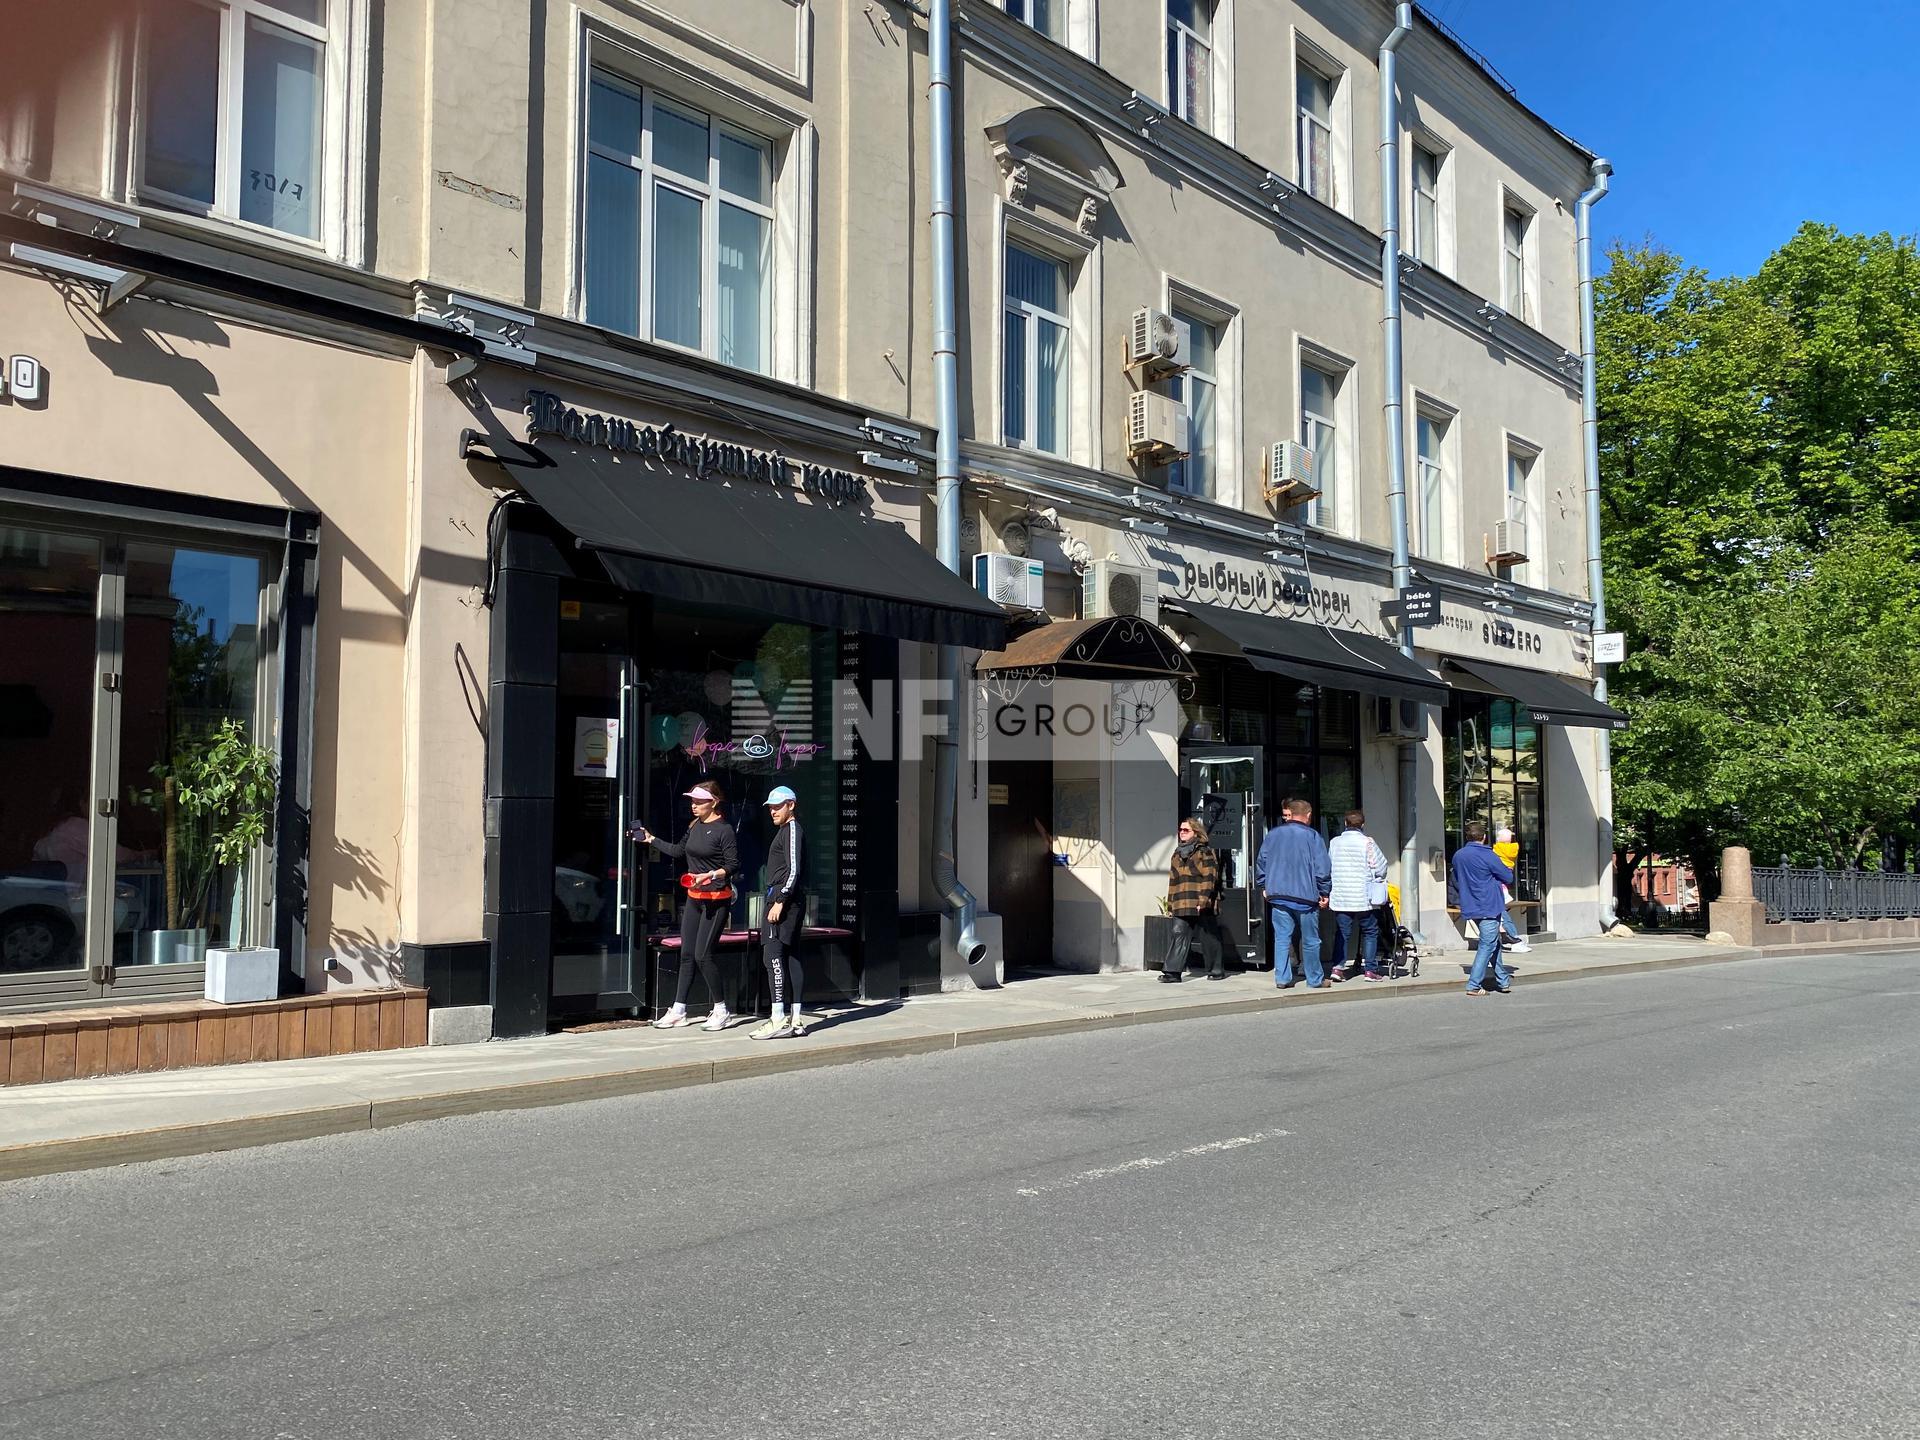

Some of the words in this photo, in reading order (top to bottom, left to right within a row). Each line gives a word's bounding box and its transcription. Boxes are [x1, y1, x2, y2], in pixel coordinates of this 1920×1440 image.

[1184, 561, 1267, 600] рыбный
[1405, 591, 1432, 601] bébé
[1421, 601, 1432, 609] la
[1408, 611, 1429, 620] mer
[1482, 622, 1542, 654] SUBZERO
